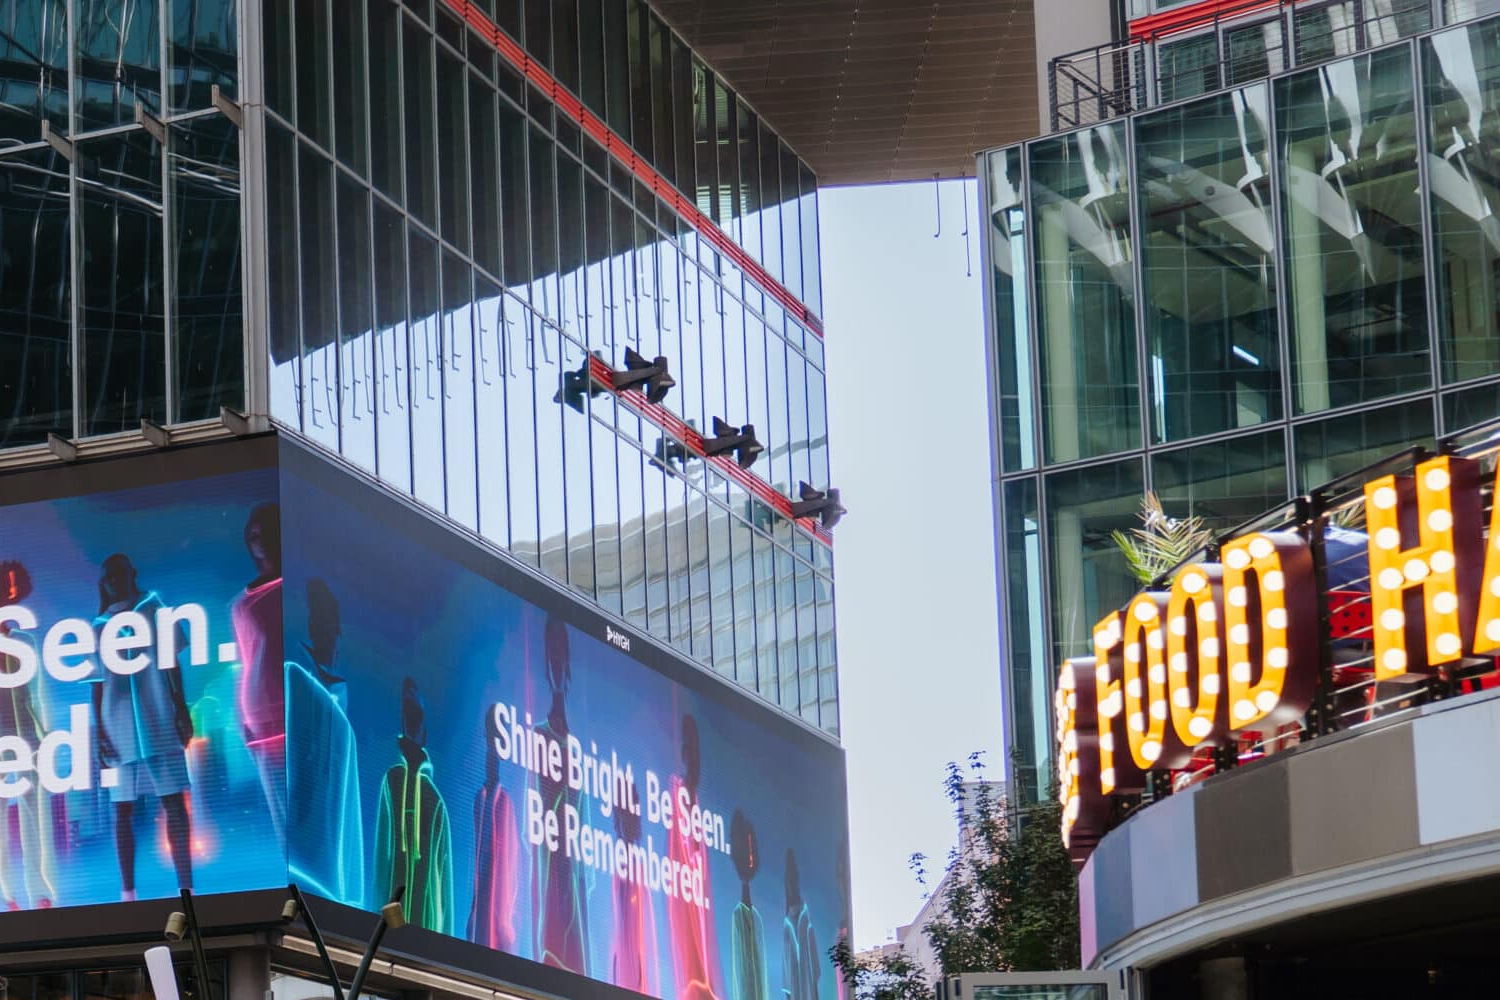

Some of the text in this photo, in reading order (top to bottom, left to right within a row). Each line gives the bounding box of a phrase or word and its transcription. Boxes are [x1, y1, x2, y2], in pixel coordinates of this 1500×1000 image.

[612, 630, 630, 651] HYGH
[1093, 532, 1290, 796] FOOD
[494, 702, 731, 855] Shine Bright. Be Seen.
[526, 789, 710, 910] Be Remembered.
